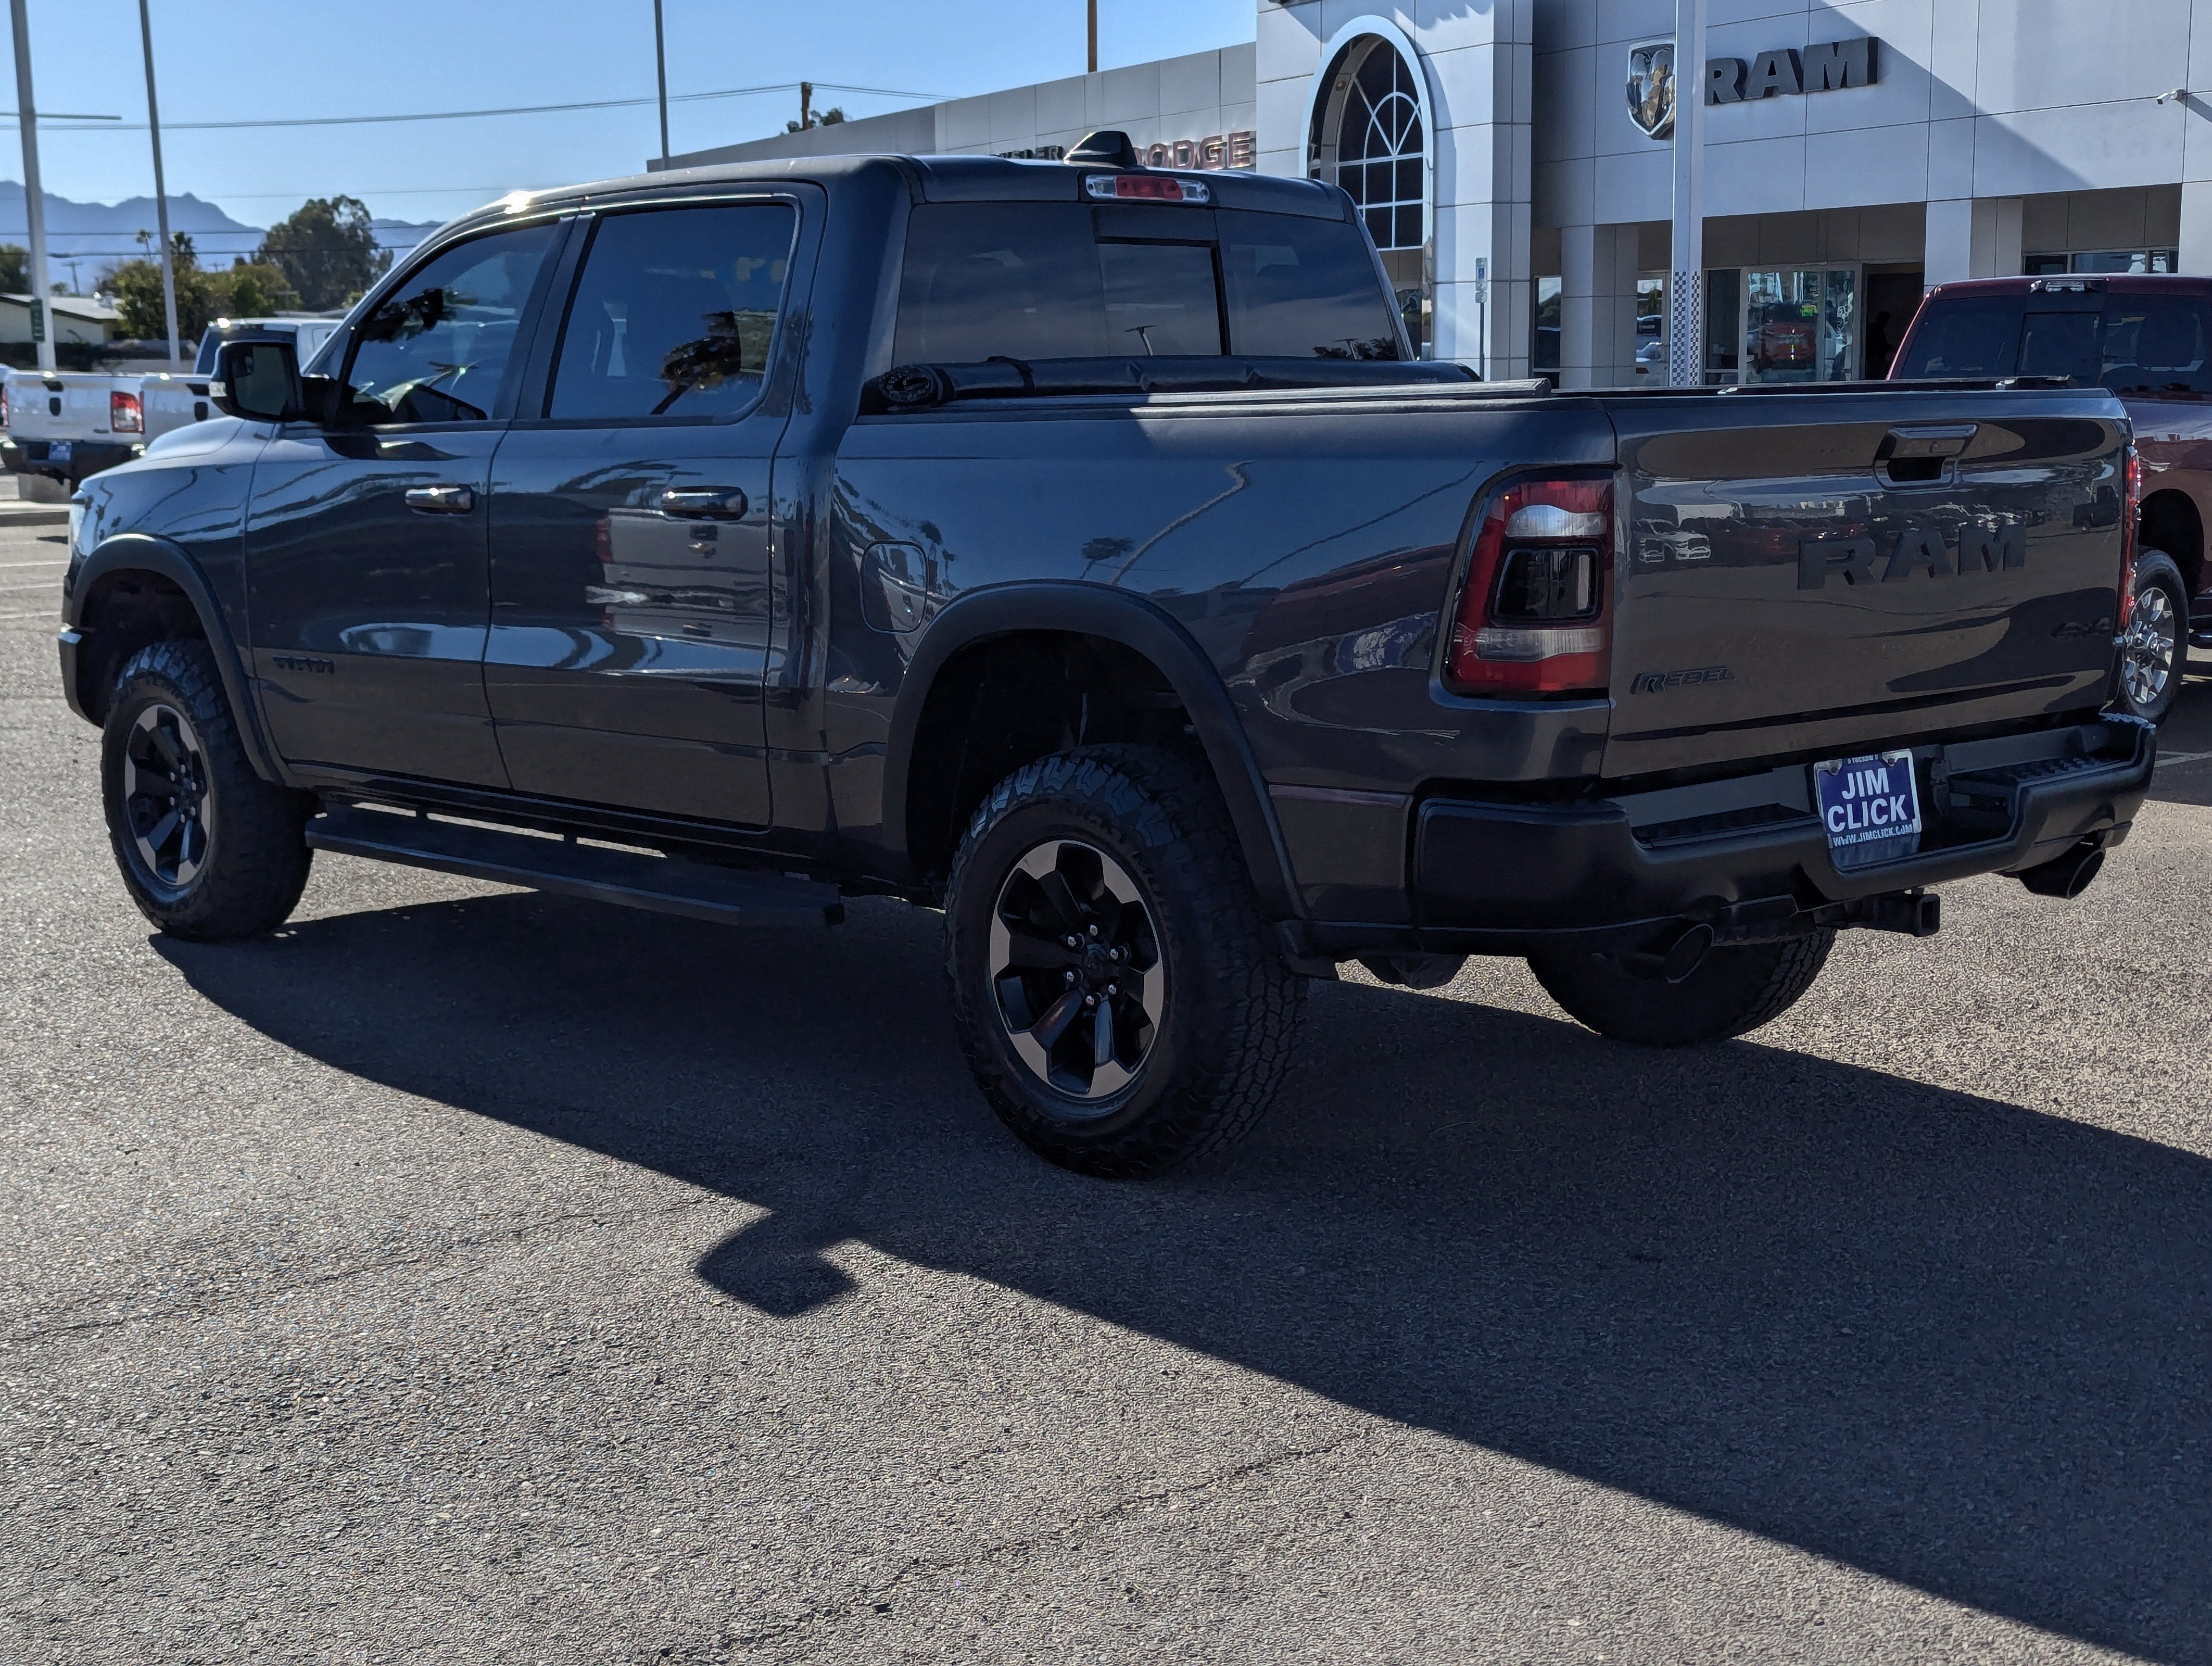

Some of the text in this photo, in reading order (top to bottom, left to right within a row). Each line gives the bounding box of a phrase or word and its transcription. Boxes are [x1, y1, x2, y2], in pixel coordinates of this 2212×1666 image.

[1704, 36, 1878, 106] RAM
[1797, 524, 2026, 590] RAM
[1630, 665, 1735, 694] REBEL
[1841, 767, 1889, 799] JIM
[1828, 794, 1908, 832] CLICK
